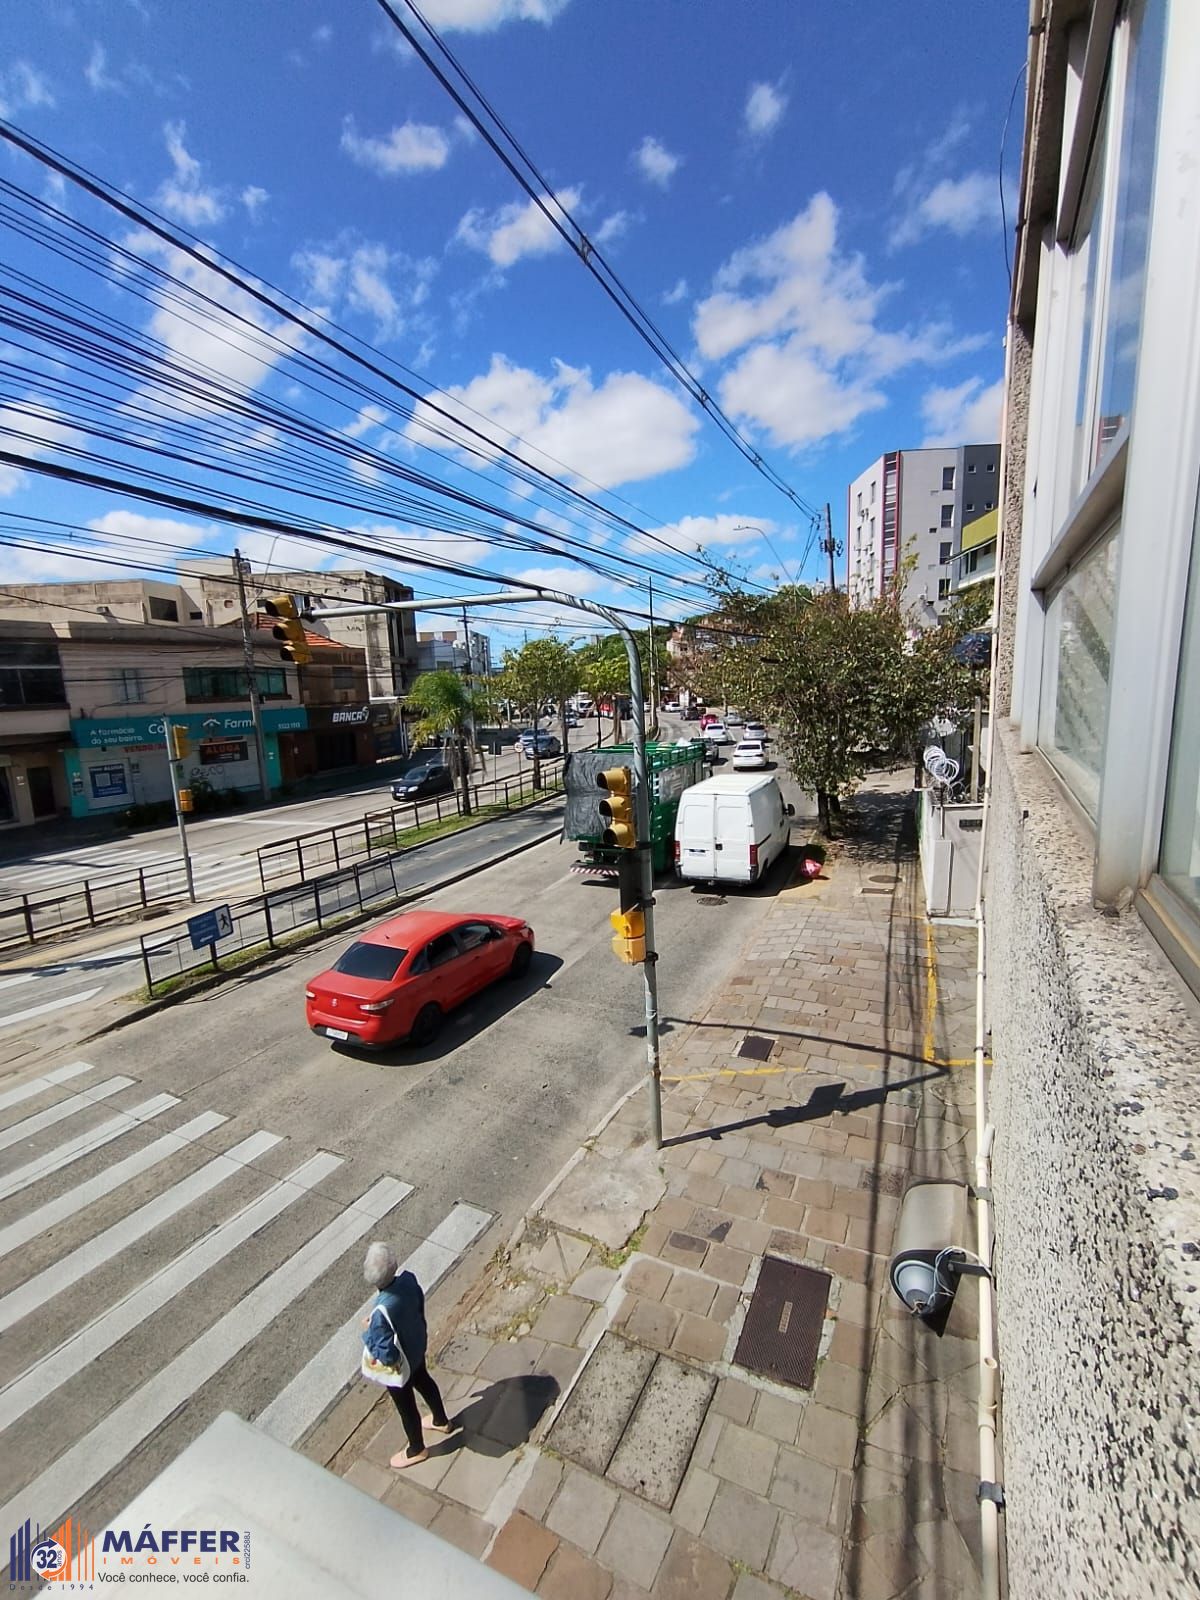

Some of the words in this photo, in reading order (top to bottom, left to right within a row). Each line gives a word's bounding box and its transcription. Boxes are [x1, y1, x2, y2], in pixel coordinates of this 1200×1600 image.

[332, 711, 363, 723] BANCA
[148, 723, 166, 734] Co
[224, 719, 253, 729] Farm
